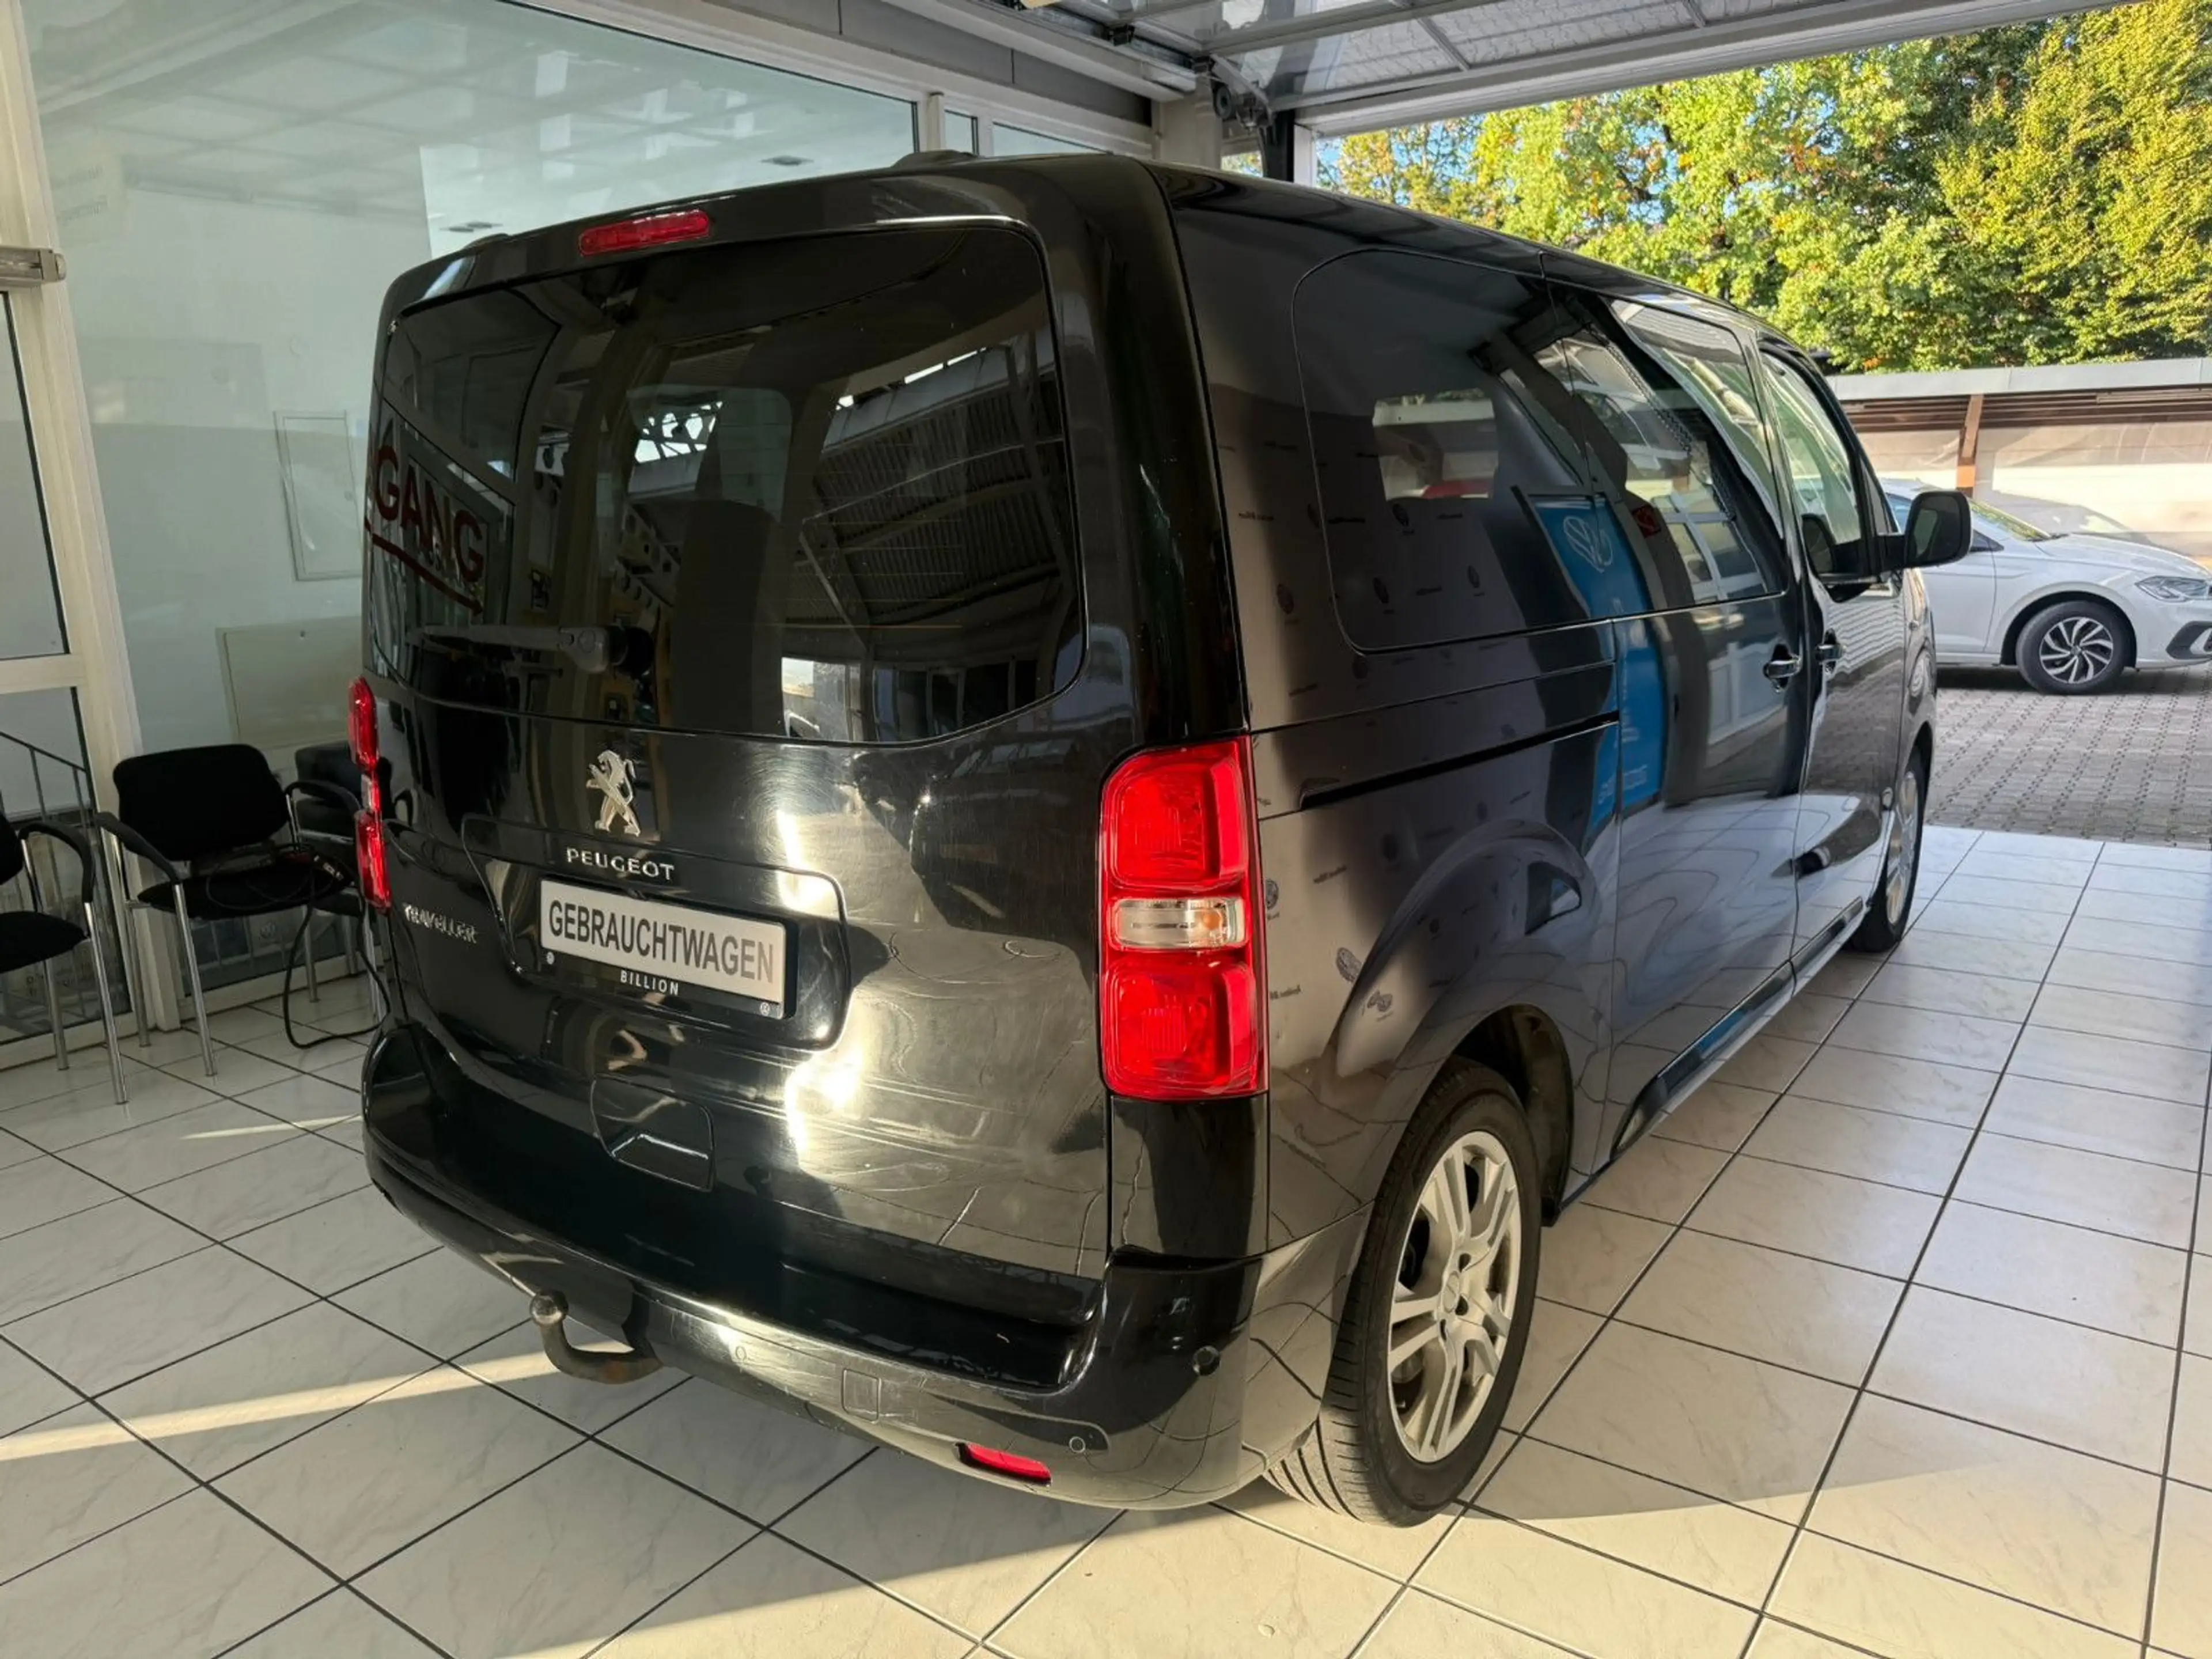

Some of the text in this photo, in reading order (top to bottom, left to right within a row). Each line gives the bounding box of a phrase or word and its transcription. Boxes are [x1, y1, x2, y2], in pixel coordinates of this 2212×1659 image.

[374, 445, 484, 582] GANG
[566, 847, 675, 880] PEUGEOT
[403, 903, 477, 944] TRAVELLER
[549, 899, 774, 983] GEBRAUCHTWAGEN
[620, 969, 679, 996] BILLION
